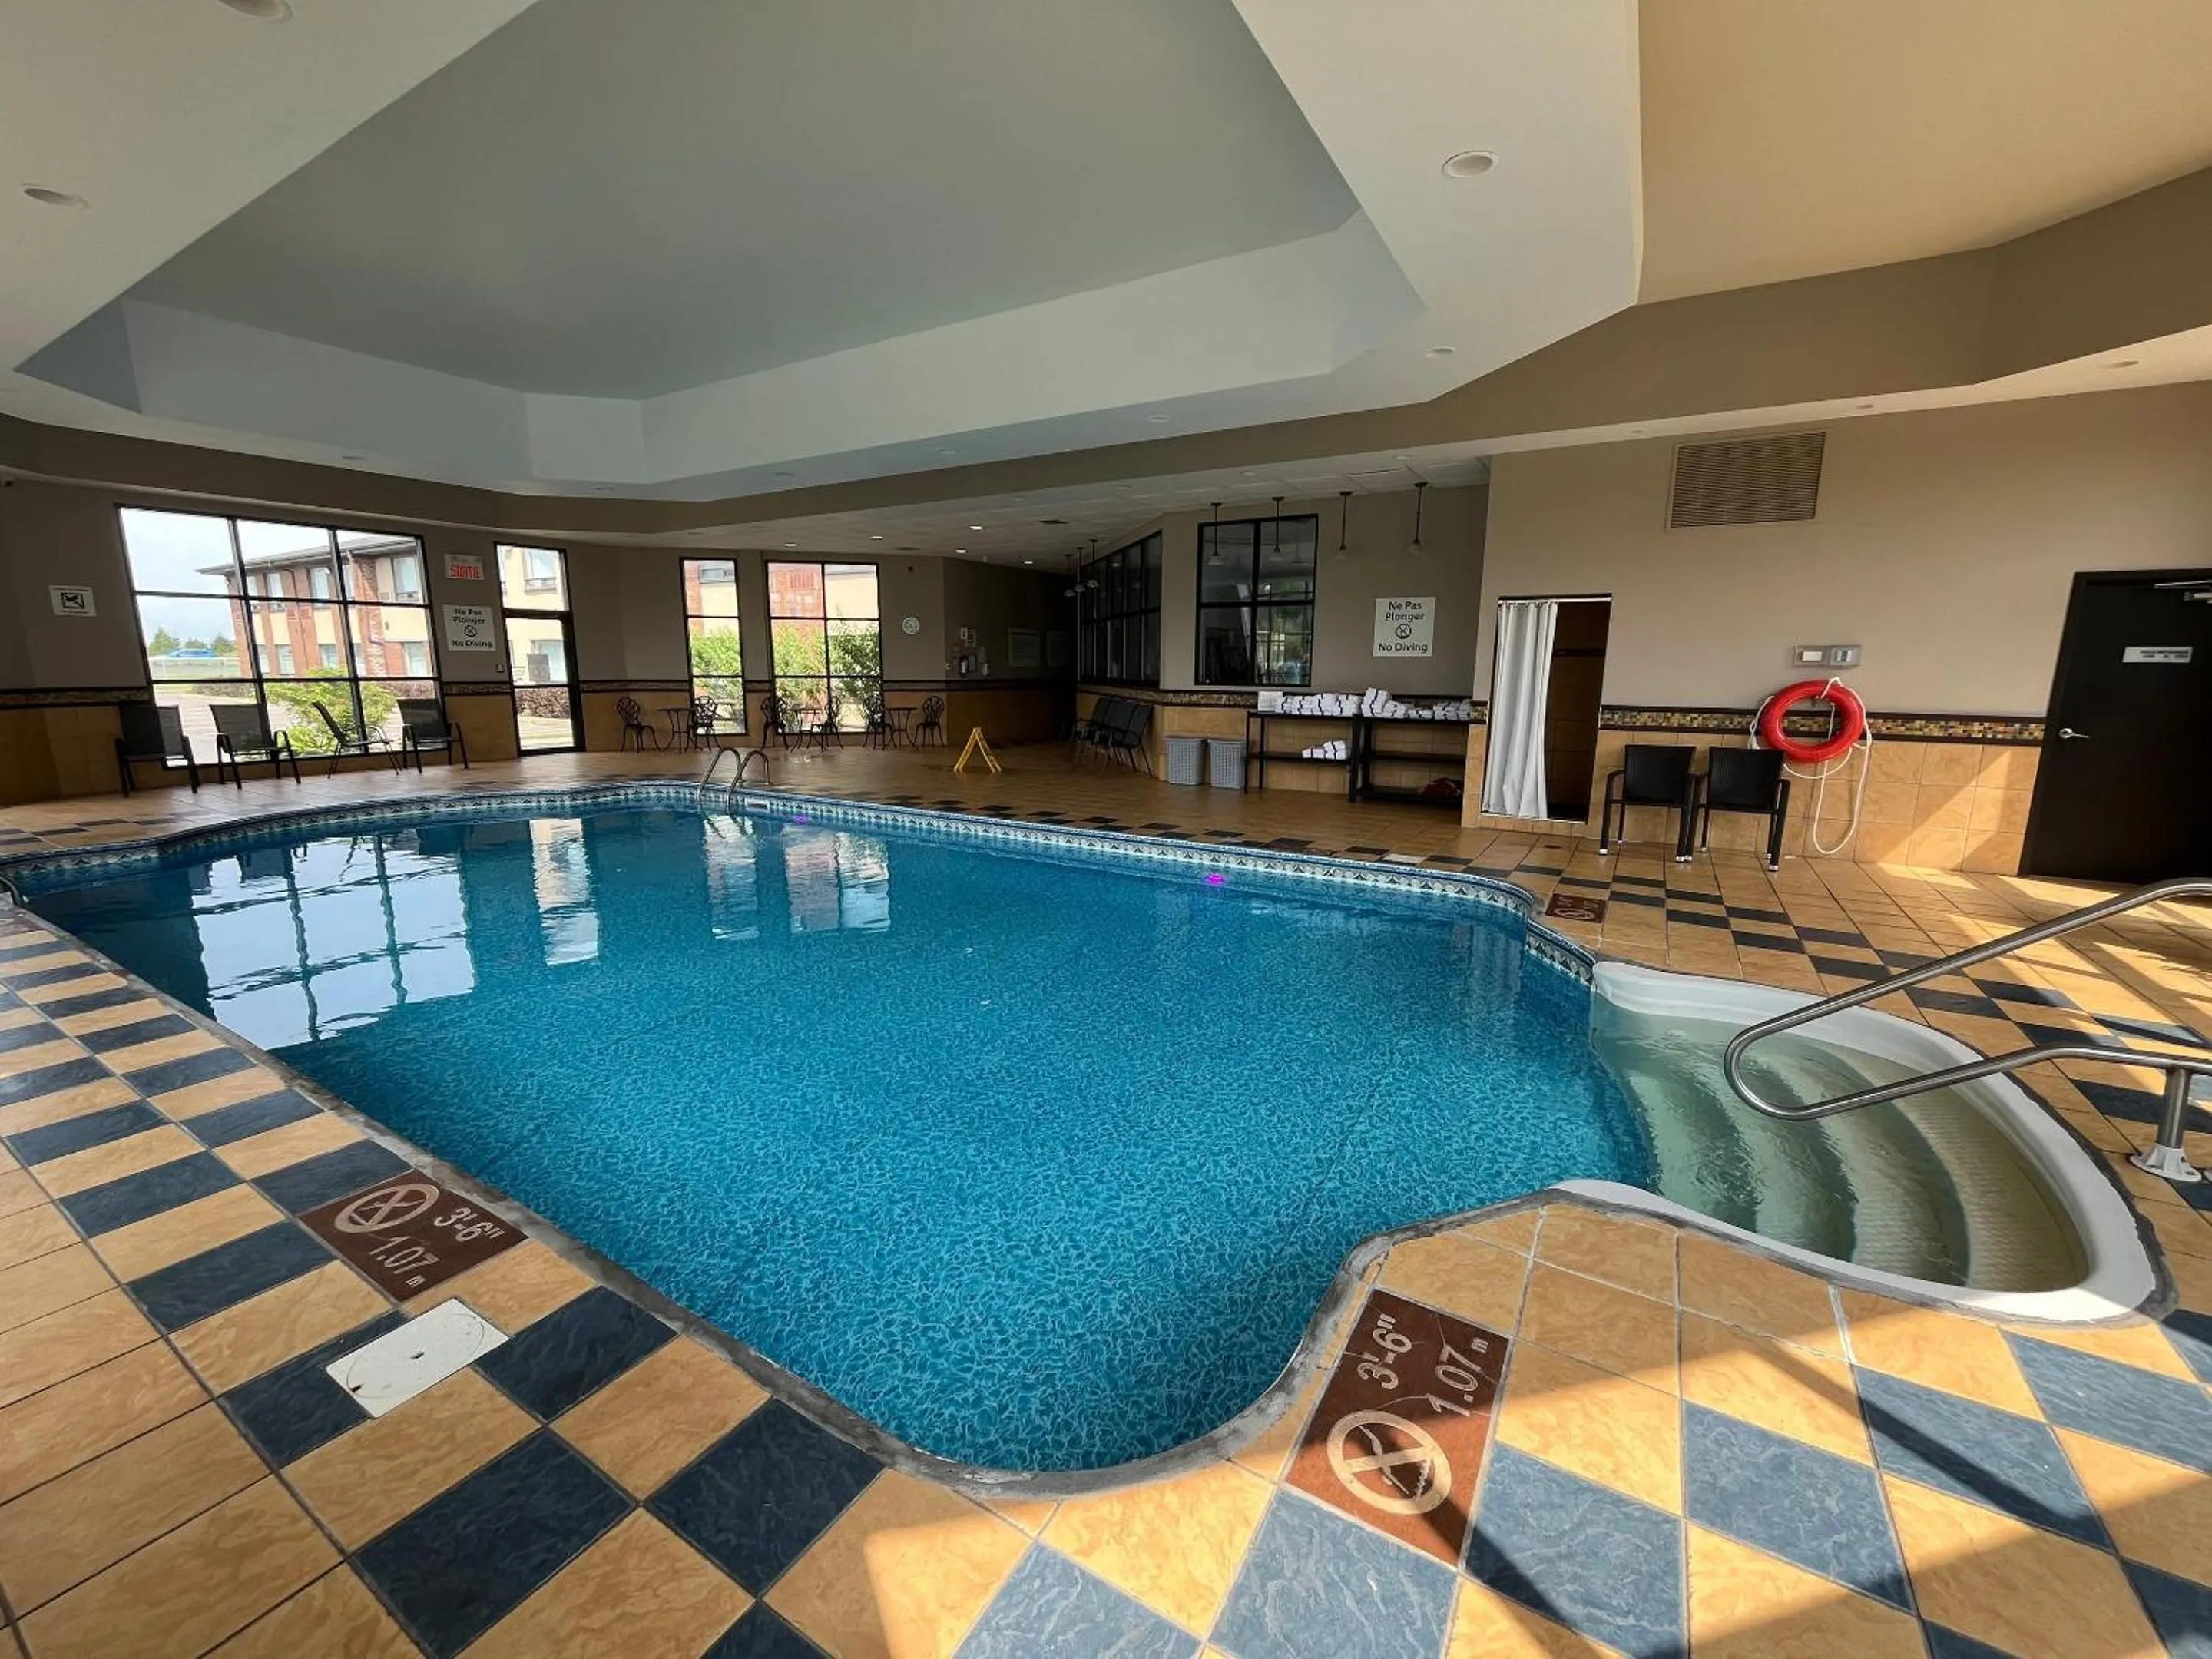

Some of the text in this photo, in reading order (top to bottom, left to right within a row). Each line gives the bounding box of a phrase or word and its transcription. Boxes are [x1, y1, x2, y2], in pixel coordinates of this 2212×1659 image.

[449, 564, 481, 578] SORTIE
[1389, 601, 1422, 611] Ne Pas
[1386, 612, 1425, 623] Plonger
[465, 639, 493, 648] Diving
[1379, 642, 1429, 654] No Diving
[369, 1235, 441, 1275] 1.07
[1426, 1343, 1482, 1417] 1.07
